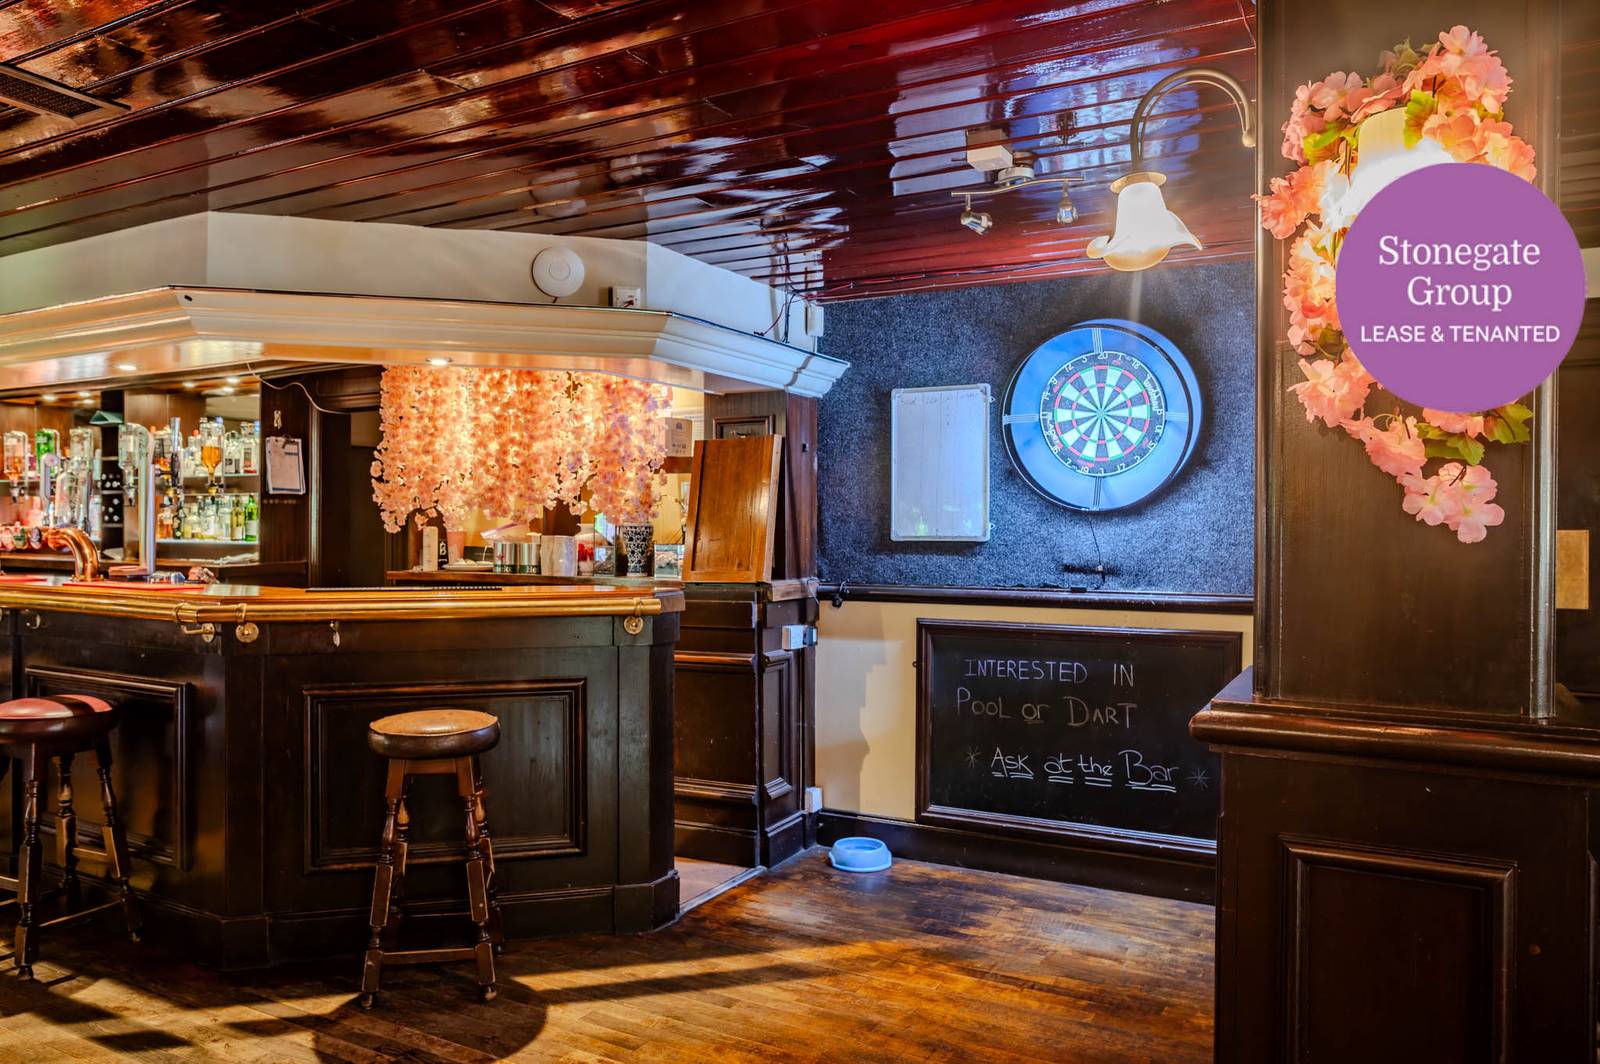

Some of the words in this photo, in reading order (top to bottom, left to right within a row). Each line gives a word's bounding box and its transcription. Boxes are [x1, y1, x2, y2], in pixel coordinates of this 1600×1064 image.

[1097, 352, 1109, 360] 20
[1064, 363, 1074, 372] 12
[1117, 463, 1126, 472] 17
[965, 659, 1088, 684] INTERESTED
[1113, 663, 1134, 687] IN
[1021, 703, 1049, 720] or
[991, 747, 1034, 778] Ask
[1044, 753, 1073, 775] at
[1076, 754, 1113, 776] the
[1118, 750, 1179, 786] Bar
